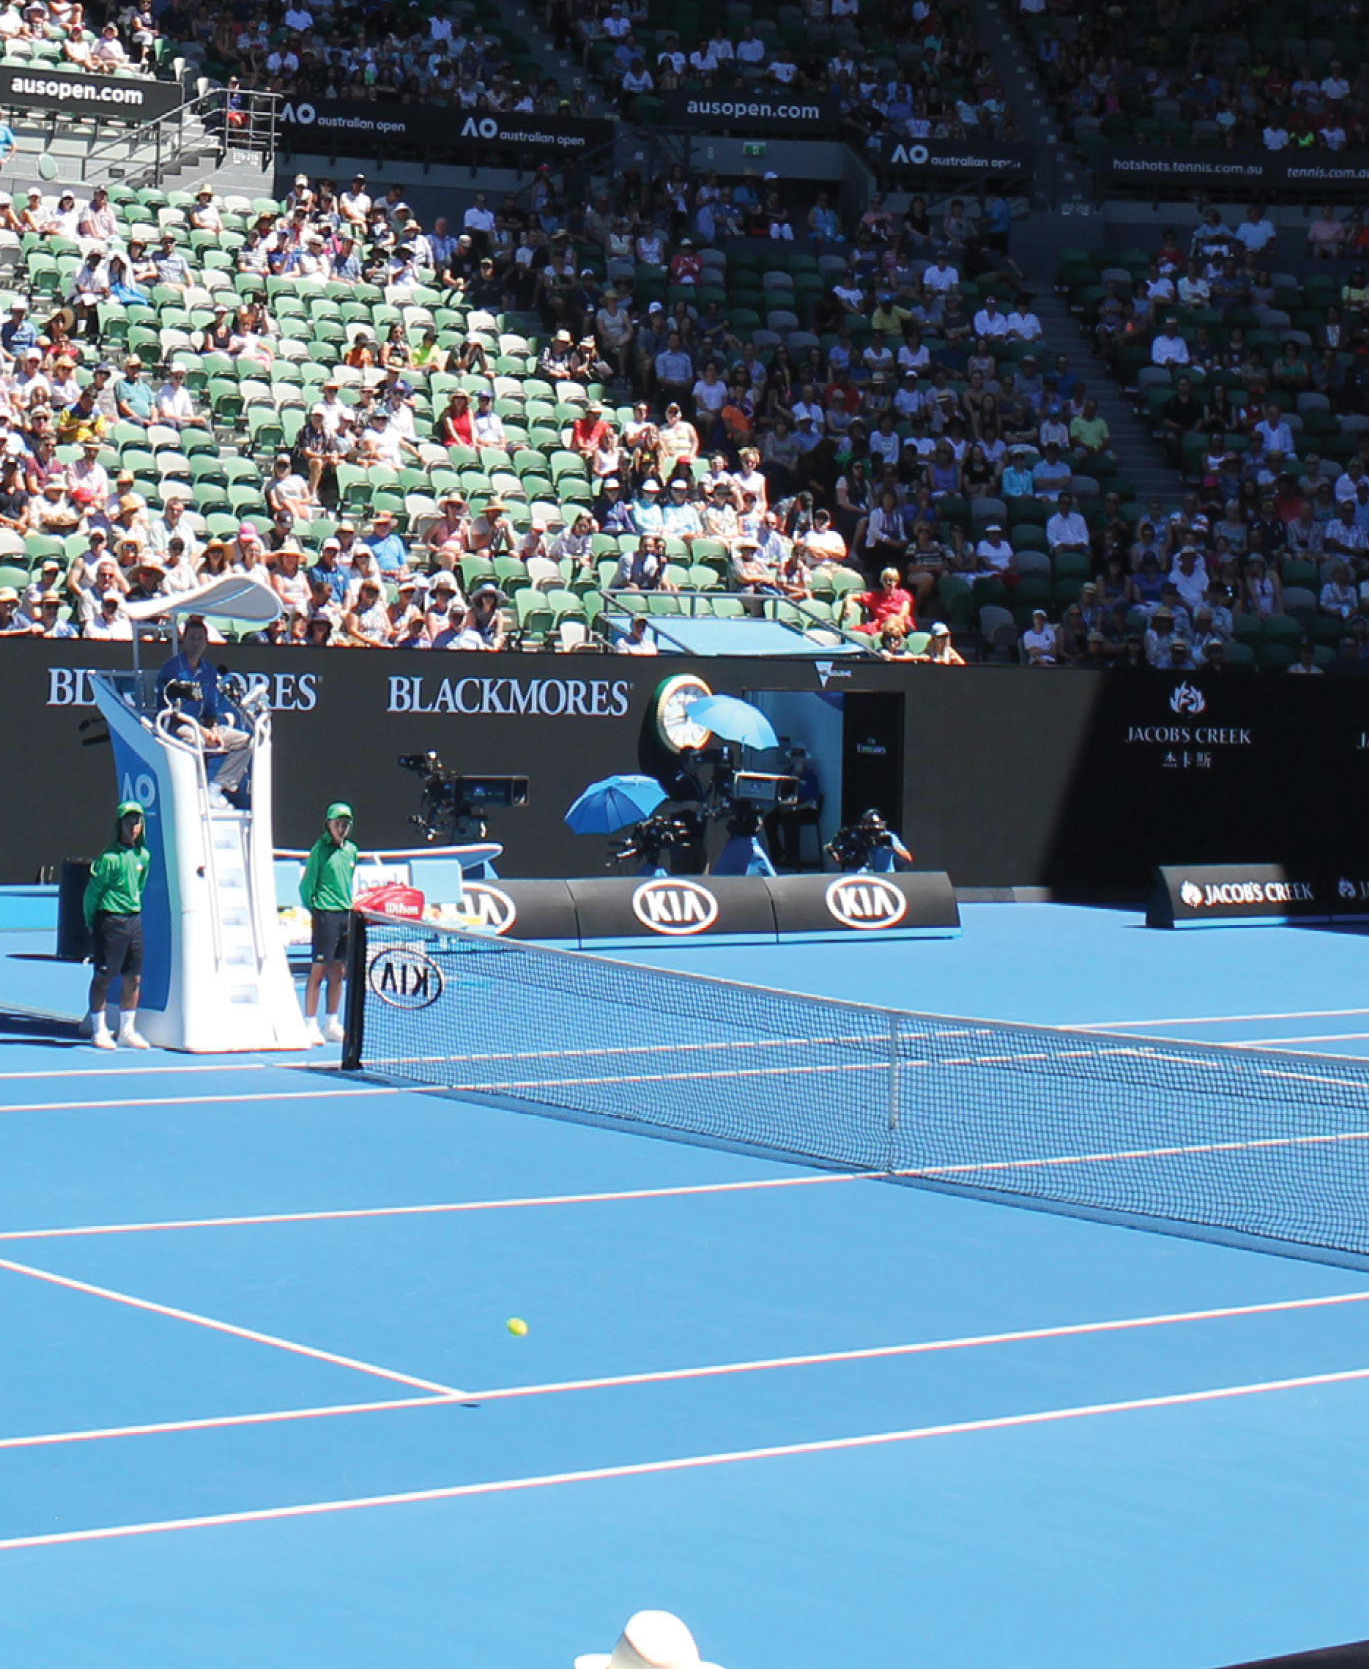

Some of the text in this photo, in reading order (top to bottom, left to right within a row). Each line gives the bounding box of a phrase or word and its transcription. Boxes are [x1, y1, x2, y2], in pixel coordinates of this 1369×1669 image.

[11, 76, 143, 106] ausopen.com
[280, 103, 406, 133] AO australian open
[687, 100, 819, 119] ausopen.com
[461, 117, 585, 147] AO australian open
[891, 144, 929, 164] AO
[930, 156, 988, 168] australian
[1113, 159, 1263, 175] hotshots.tennis.com.au
[387, 675, 629, 716] BLACKMORES
[1126, 727, 1252, 745] JACOB'S CREEK
[645, 890, 709, 922] KIA
[836, 886, 899, 918] KIA
[1204, 881, 1314, 907] JACOB'S CREEK
[384, 901, 420, 916] Wilson
